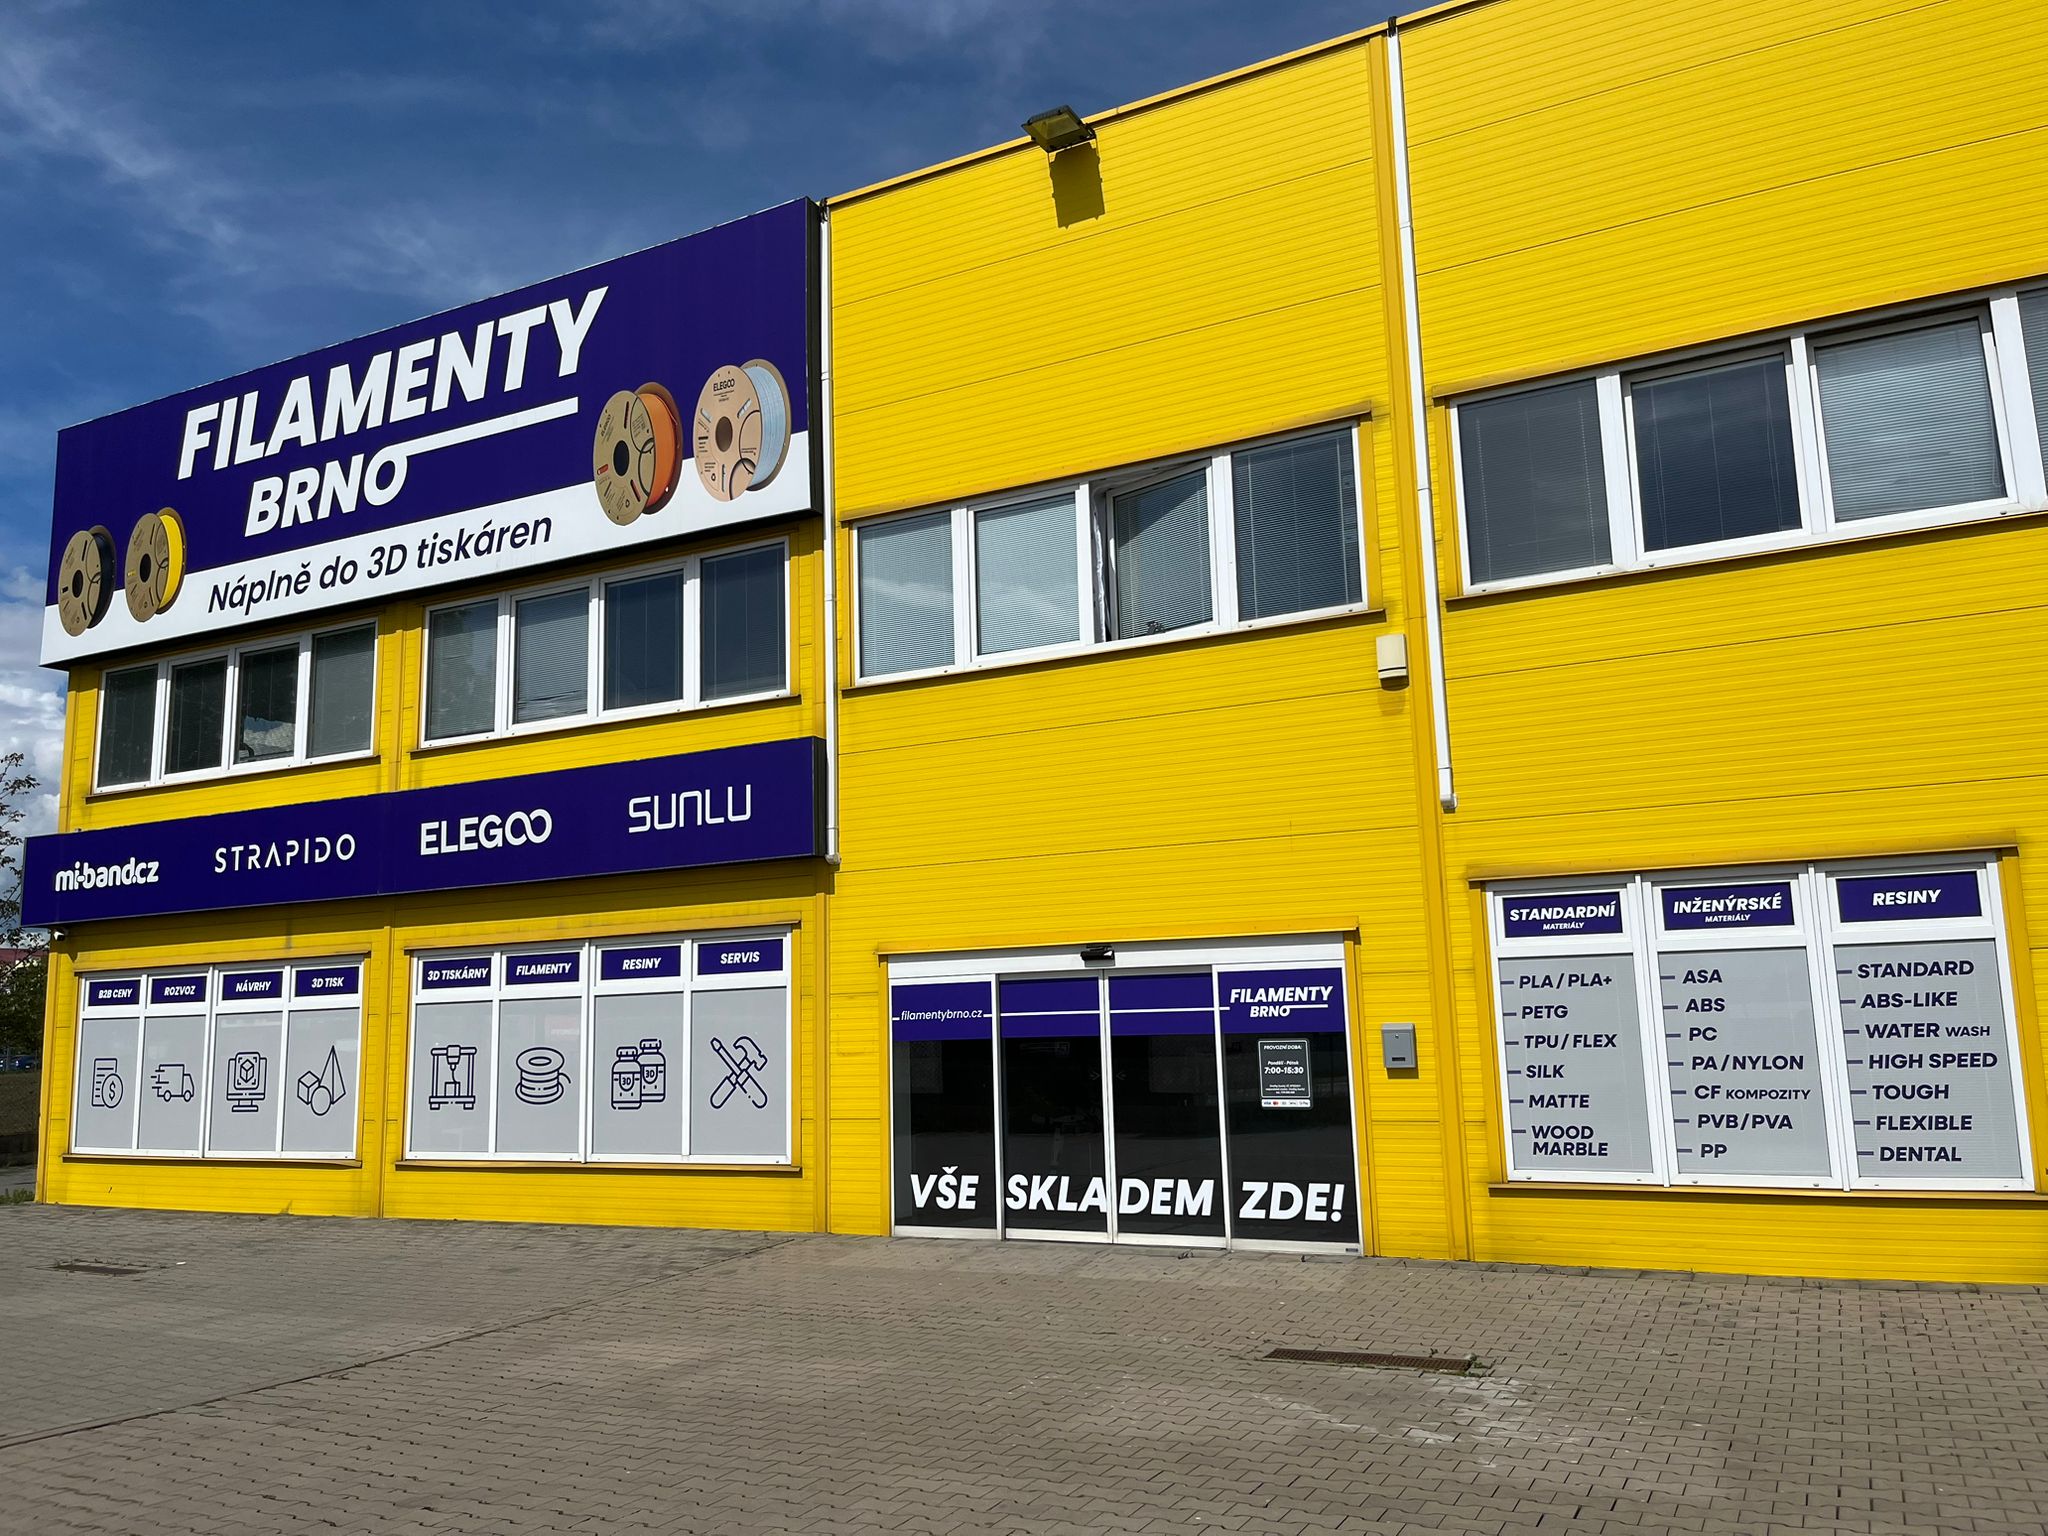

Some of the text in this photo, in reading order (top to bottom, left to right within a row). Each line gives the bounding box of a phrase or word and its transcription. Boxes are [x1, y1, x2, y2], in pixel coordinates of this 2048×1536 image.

[177, 286, 609, 480] FILAMENTY
[244, 445, 408, 538] BRNO
[208, 518, 551, 615] Náplně do 3D tiskáren
[629, 785, 751, 833] SUNLU
[421, 809, 552, 855] ELEGOO
[215, 834, 355, 873] STRAPIDO
[55, 857, 159, 891] mi-band.cz
[1674, 892, 1781, 913] INŽENÝRSKÉ
[1873, 890, 1941, 905] RESINY
[1510, 901, 1616, 921] STANDARDNÍ
[1705, 914, 1750, 922] MATERIÁLY
[623, 958, 661, 969] RESINY
[721, 952, 760, 964] SERVIS
[428, 966, 488, 980] 3D TISKÁRNY
[516, 963, 571, 975] FILAMENTY
[1858, 961, 1974, 978] STANDARD
[312, 977, 344, 988] 3D TISK
[1683, 970, 1722, 983] ASA
[164, 986, 195, 995] ROZVOZ
[236, 980, 271, 992] NÁVRHY
[98, 989, 132, 998] B2B CENY
[1230, 986, 1333, 1003] FILAMENTY
[1861, 992, 1957, 1008] ABS-LIKE
[1250, 1005, 1291, 1018] BRNO
[1522, 1005, 1568, 1019] PETG
[1686, 998, 1725, 1012] ABS
[901, 1009, 983, 1022] filamentybrno.cz
[1689, 1027, 1717, 1041] PC
[1865, 1023, 1990, 1038] WATER WASH
[1869, 1053, 1997, 1069] HIGH SPEED
[645, 1069, 655, 1079] 3D
[1526, 1065, 1564, 1078] SILK
[621, 1077, 632, 1086] 3D
[1695, 1085, 1810, 1099] CF KOMPOZITY
[1873, 1085, 1949, 1099] TOUGH
[1529, 1095, 1589, 1108] MATTE
[1877, 1115, 1972, 1130] FLEXIBLE
[1532, 1126, 1593, 1139] WOOD
[1533, 1142, 1608, 1156] MARBLE
[1701, 1144, 1727, 1158] PP
[1880, 1147, 1961, 1161] DENTAL
[911, 1166, 1344, 1221] VŠE SKLADEM ZDE!
